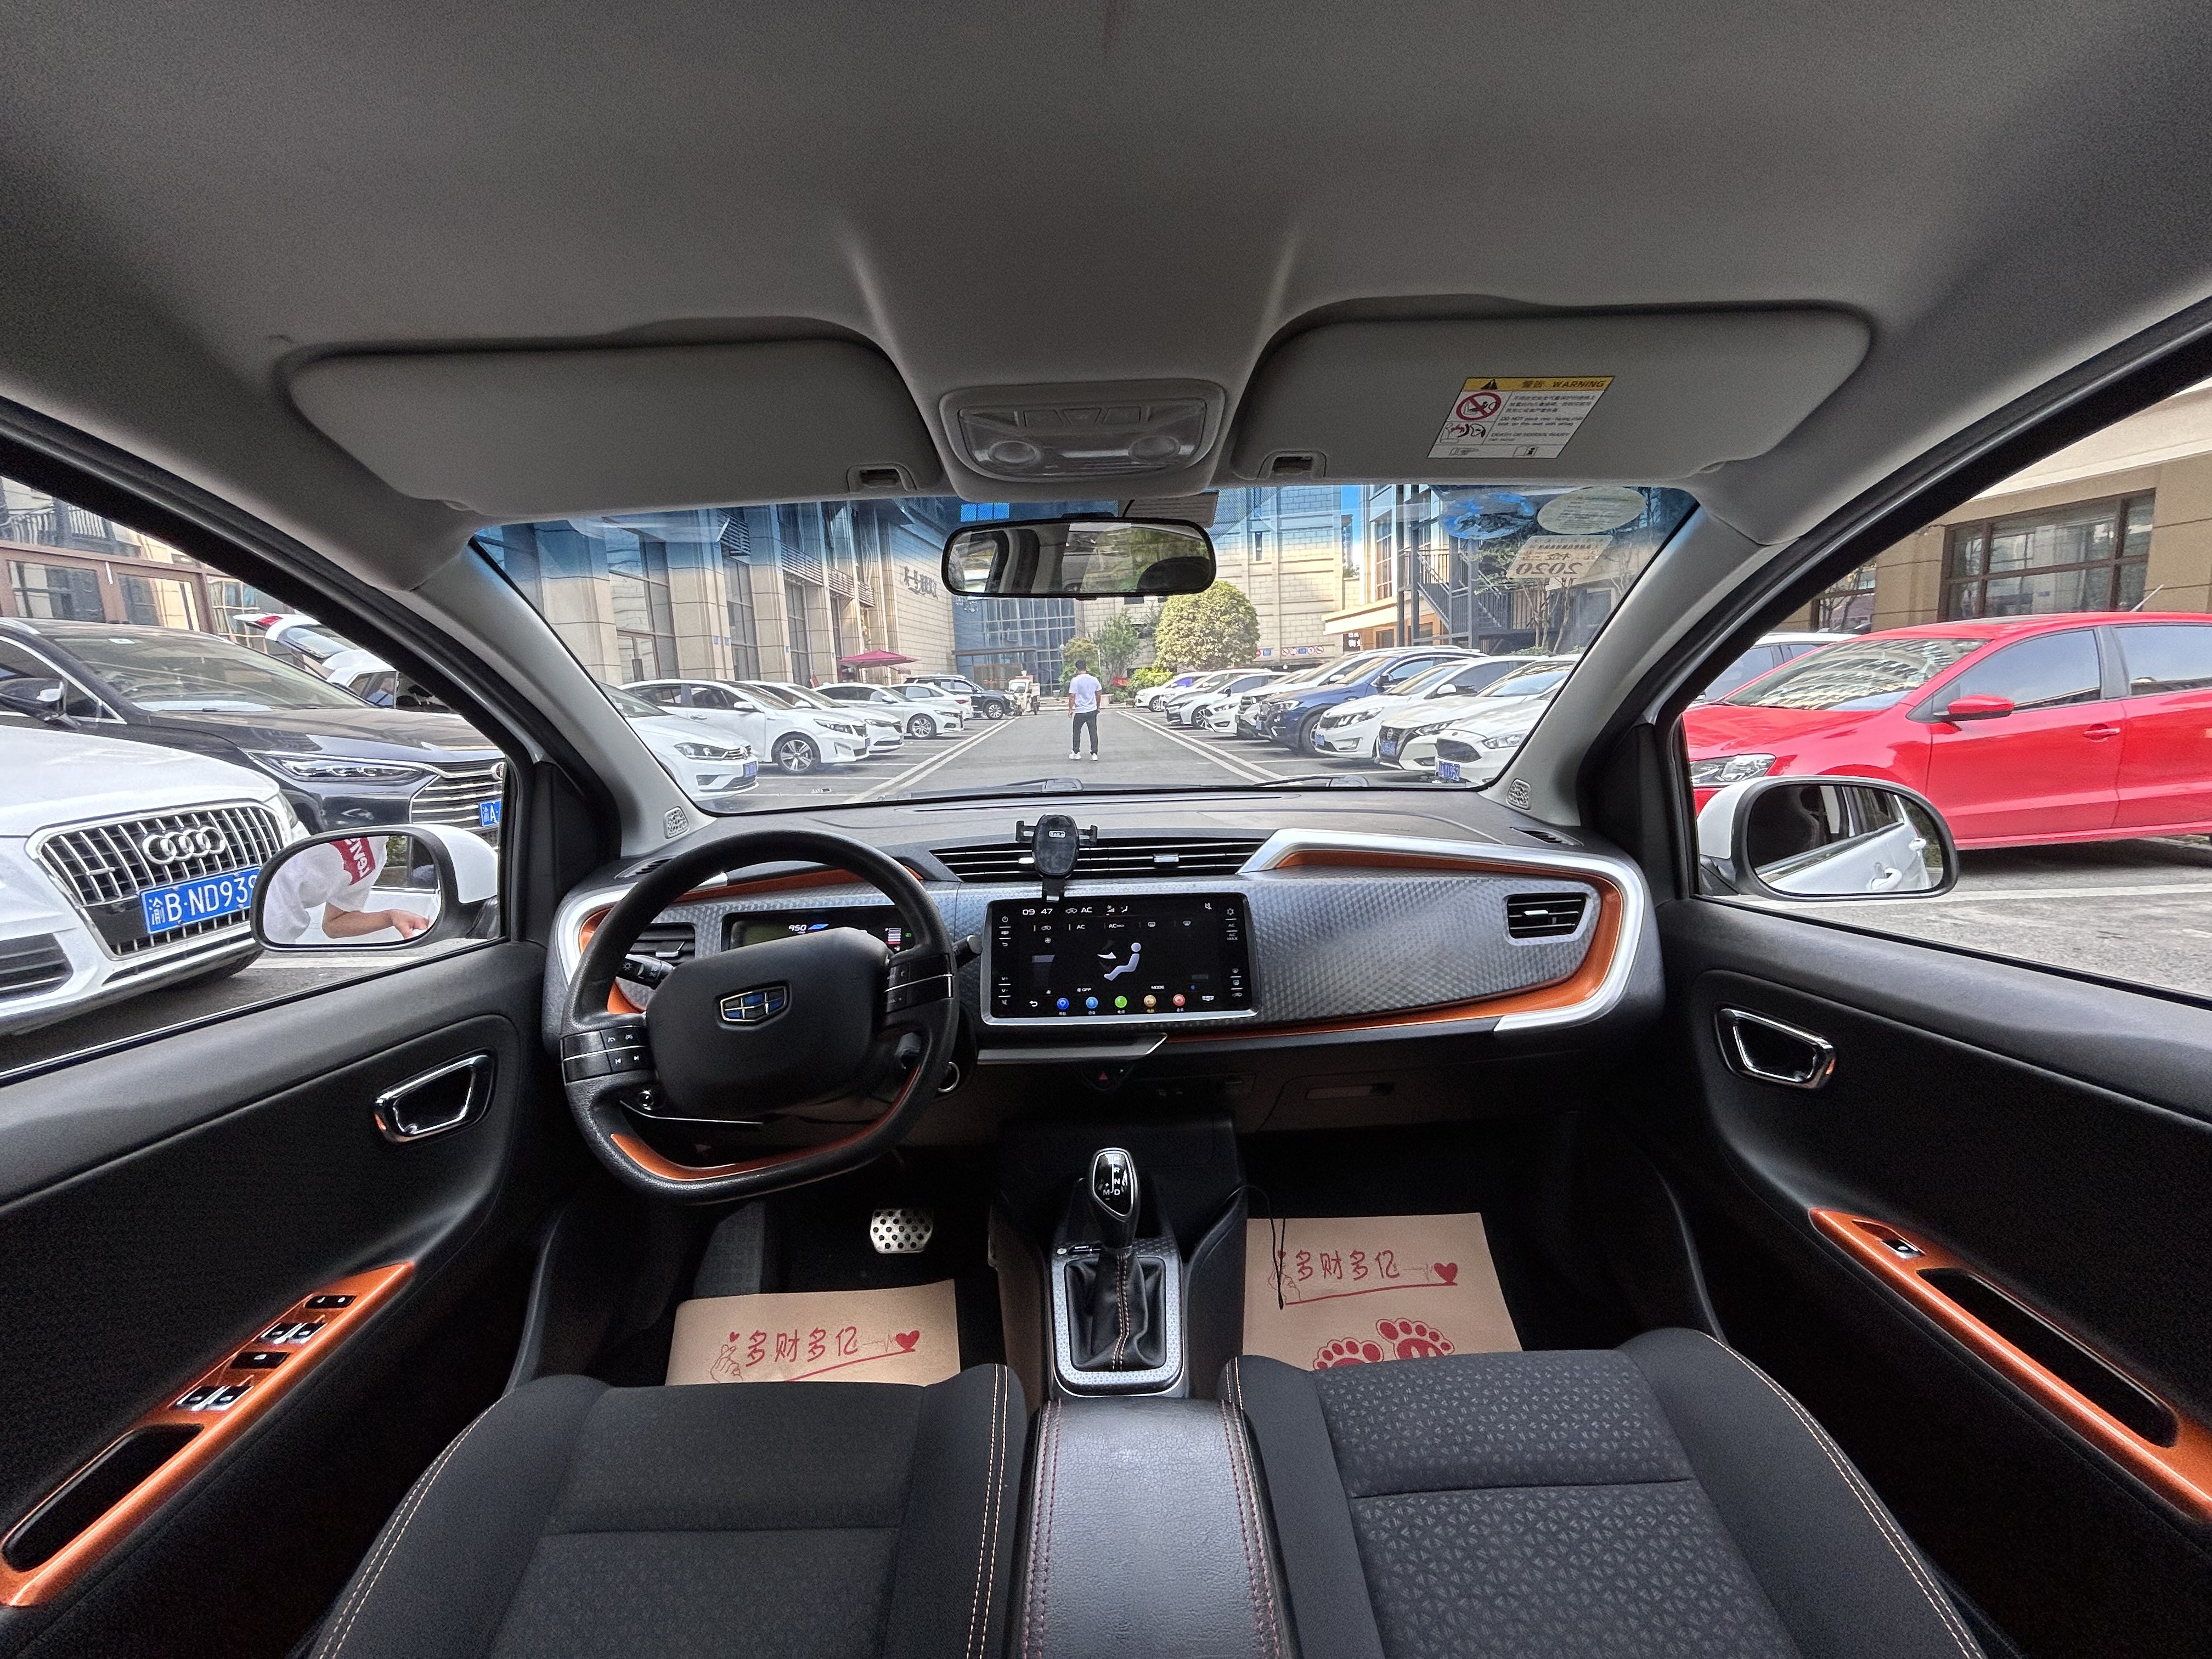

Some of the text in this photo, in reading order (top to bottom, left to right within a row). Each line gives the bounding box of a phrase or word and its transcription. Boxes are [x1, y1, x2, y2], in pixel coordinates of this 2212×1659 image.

[1295, 1250, 1400, 1281] 多财多亿
[746, 1326, 859, 1367] 多财多亿
